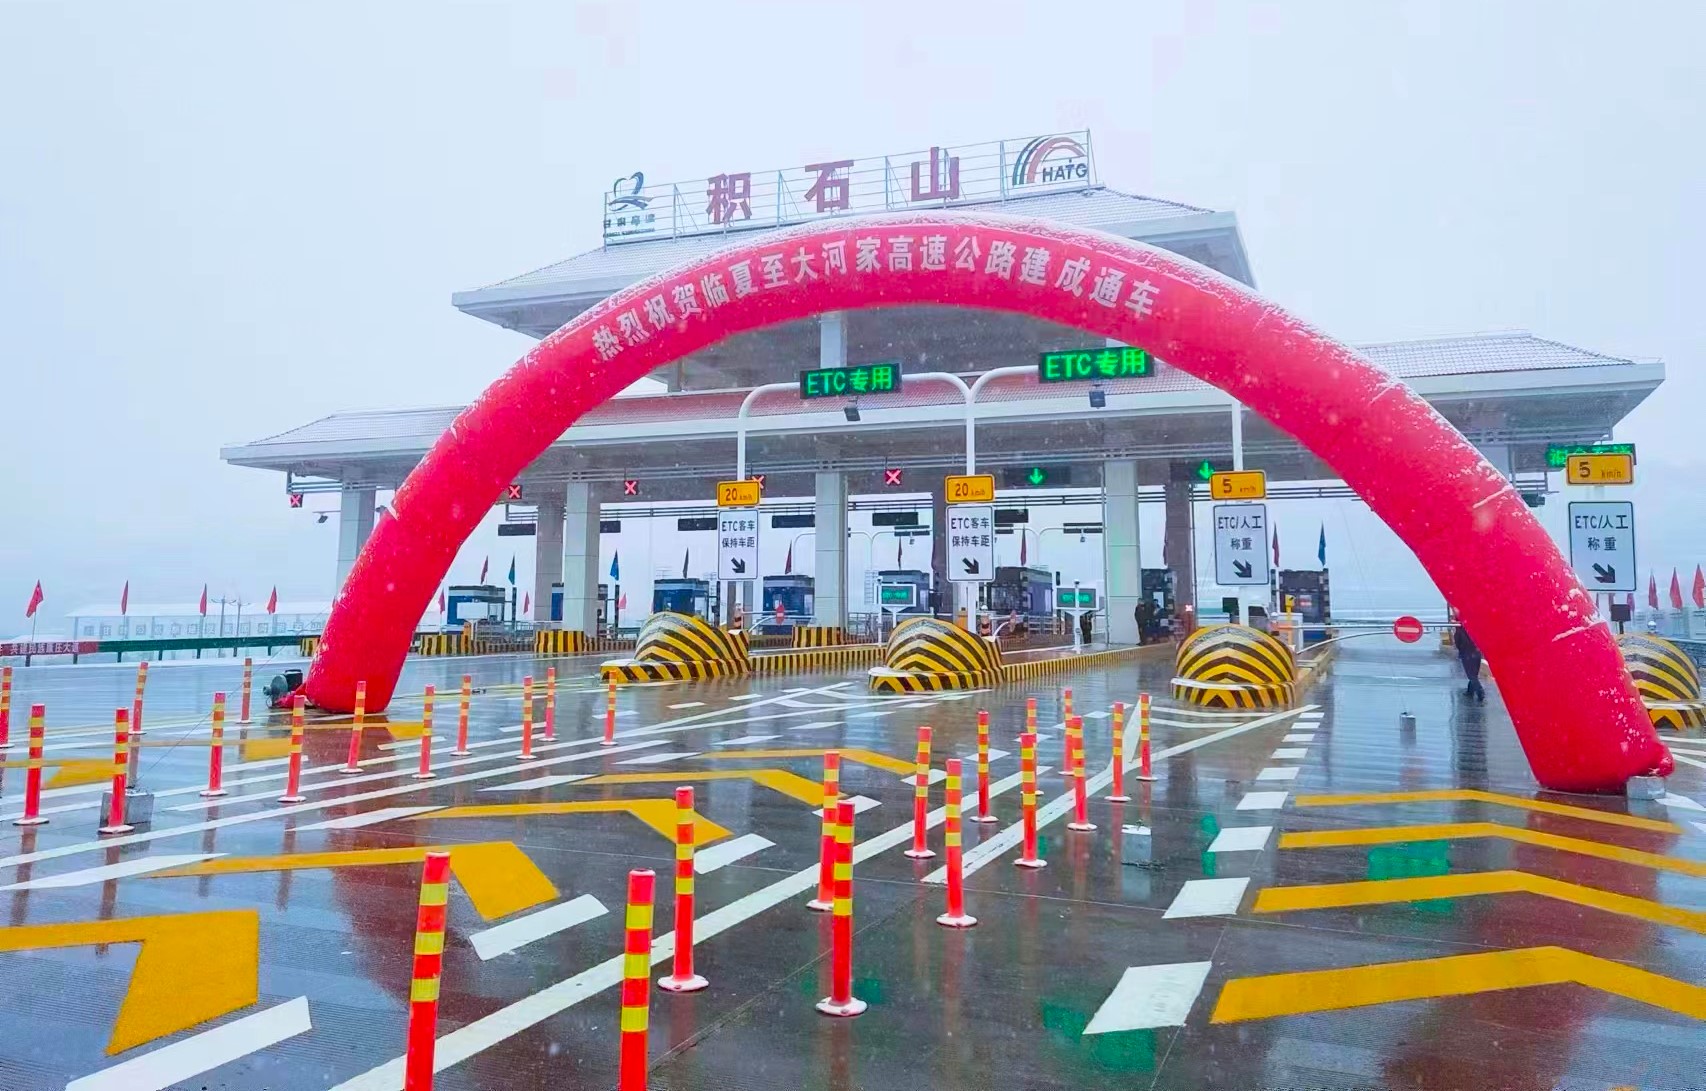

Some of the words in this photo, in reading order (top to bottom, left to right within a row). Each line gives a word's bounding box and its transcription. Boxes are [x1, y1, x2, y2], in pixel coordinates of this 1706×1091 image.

[1042, 160, 1088, 183] HATG
[706, 146, 960, 225] 积石山
[591, 234, 1160, 362] 热烈祝贺临夏至大河家高速公路建成通车
[1045, 347, 1146, 379] ETC专用
[806, 366, 893, 395] ETC专用
[1579, 462, 1591, 478] 5
[955, 483, 969, 497] 20
[1222, 478, 1233, 493] 5
[725, 487, 738, 501] 20
[721, 519, 756, 532] ETC客车
[951, 517, 991, 530] ETC客车
[1217, 515, 1263, 530] ETC/人工
[1574, 515, 1629, 530] ETC/人工
[721, 536, 756, 549] 保持车距
[951, 535, 991, 548] 保持车距
[1230, 537, 1253, 551] 称重
[1588, 536, 1617, 551] 称重
